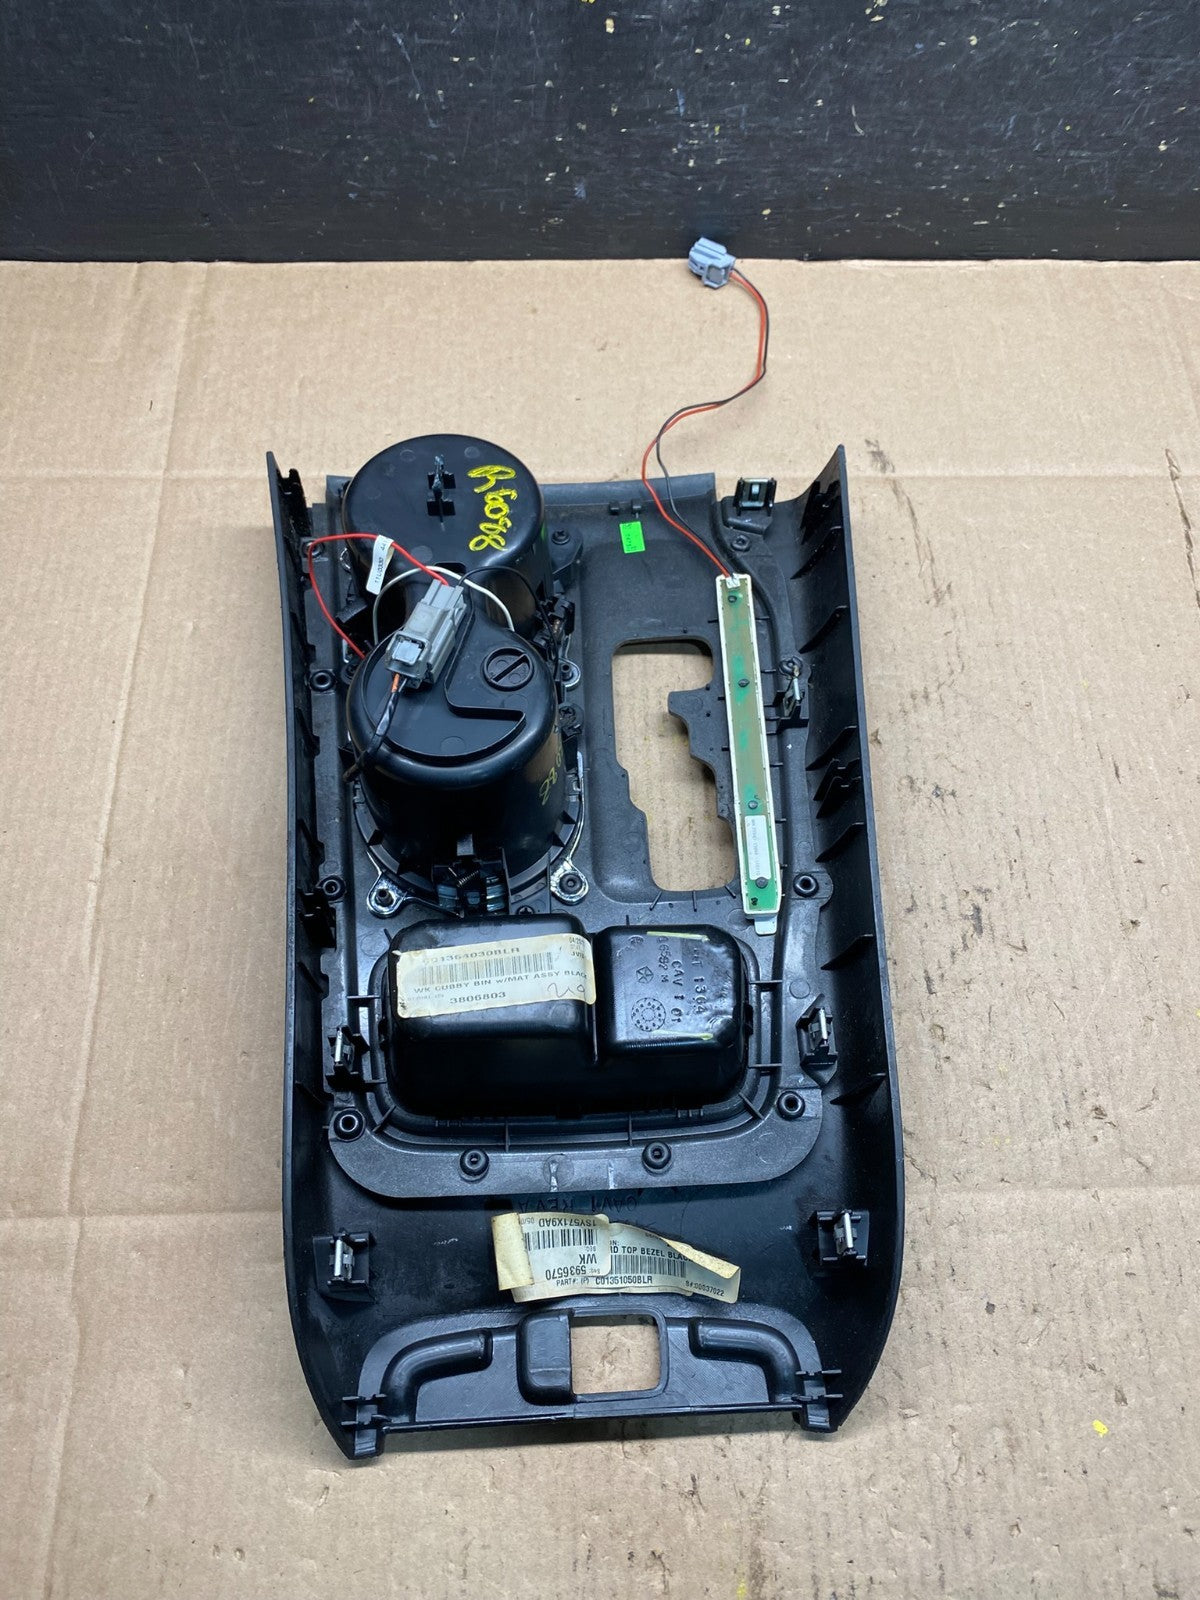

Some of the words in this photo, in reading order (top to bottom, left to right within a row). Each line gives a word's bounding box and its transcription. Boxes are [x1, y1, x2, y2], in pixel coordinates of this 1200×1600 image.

[414, 986, 431, 994] WK
[435, 981, 470, 992] CUBBY
[473, 978, 491, 987] BIN
[533, 970, 560, 980] ASSY
[449, 991, 506, 1005] 3806803
[538, 1218, 597, 1228] 1SY571X9AD
[622, 1246, 638, 1254] TOP
[640, 1247, 665, 1258] BEZEL
[579, 1253, 597, 1265] WK
[545, 1265, 587, 1281] 5936570
[595, 1275, 653, 1285] C01351050BLR
